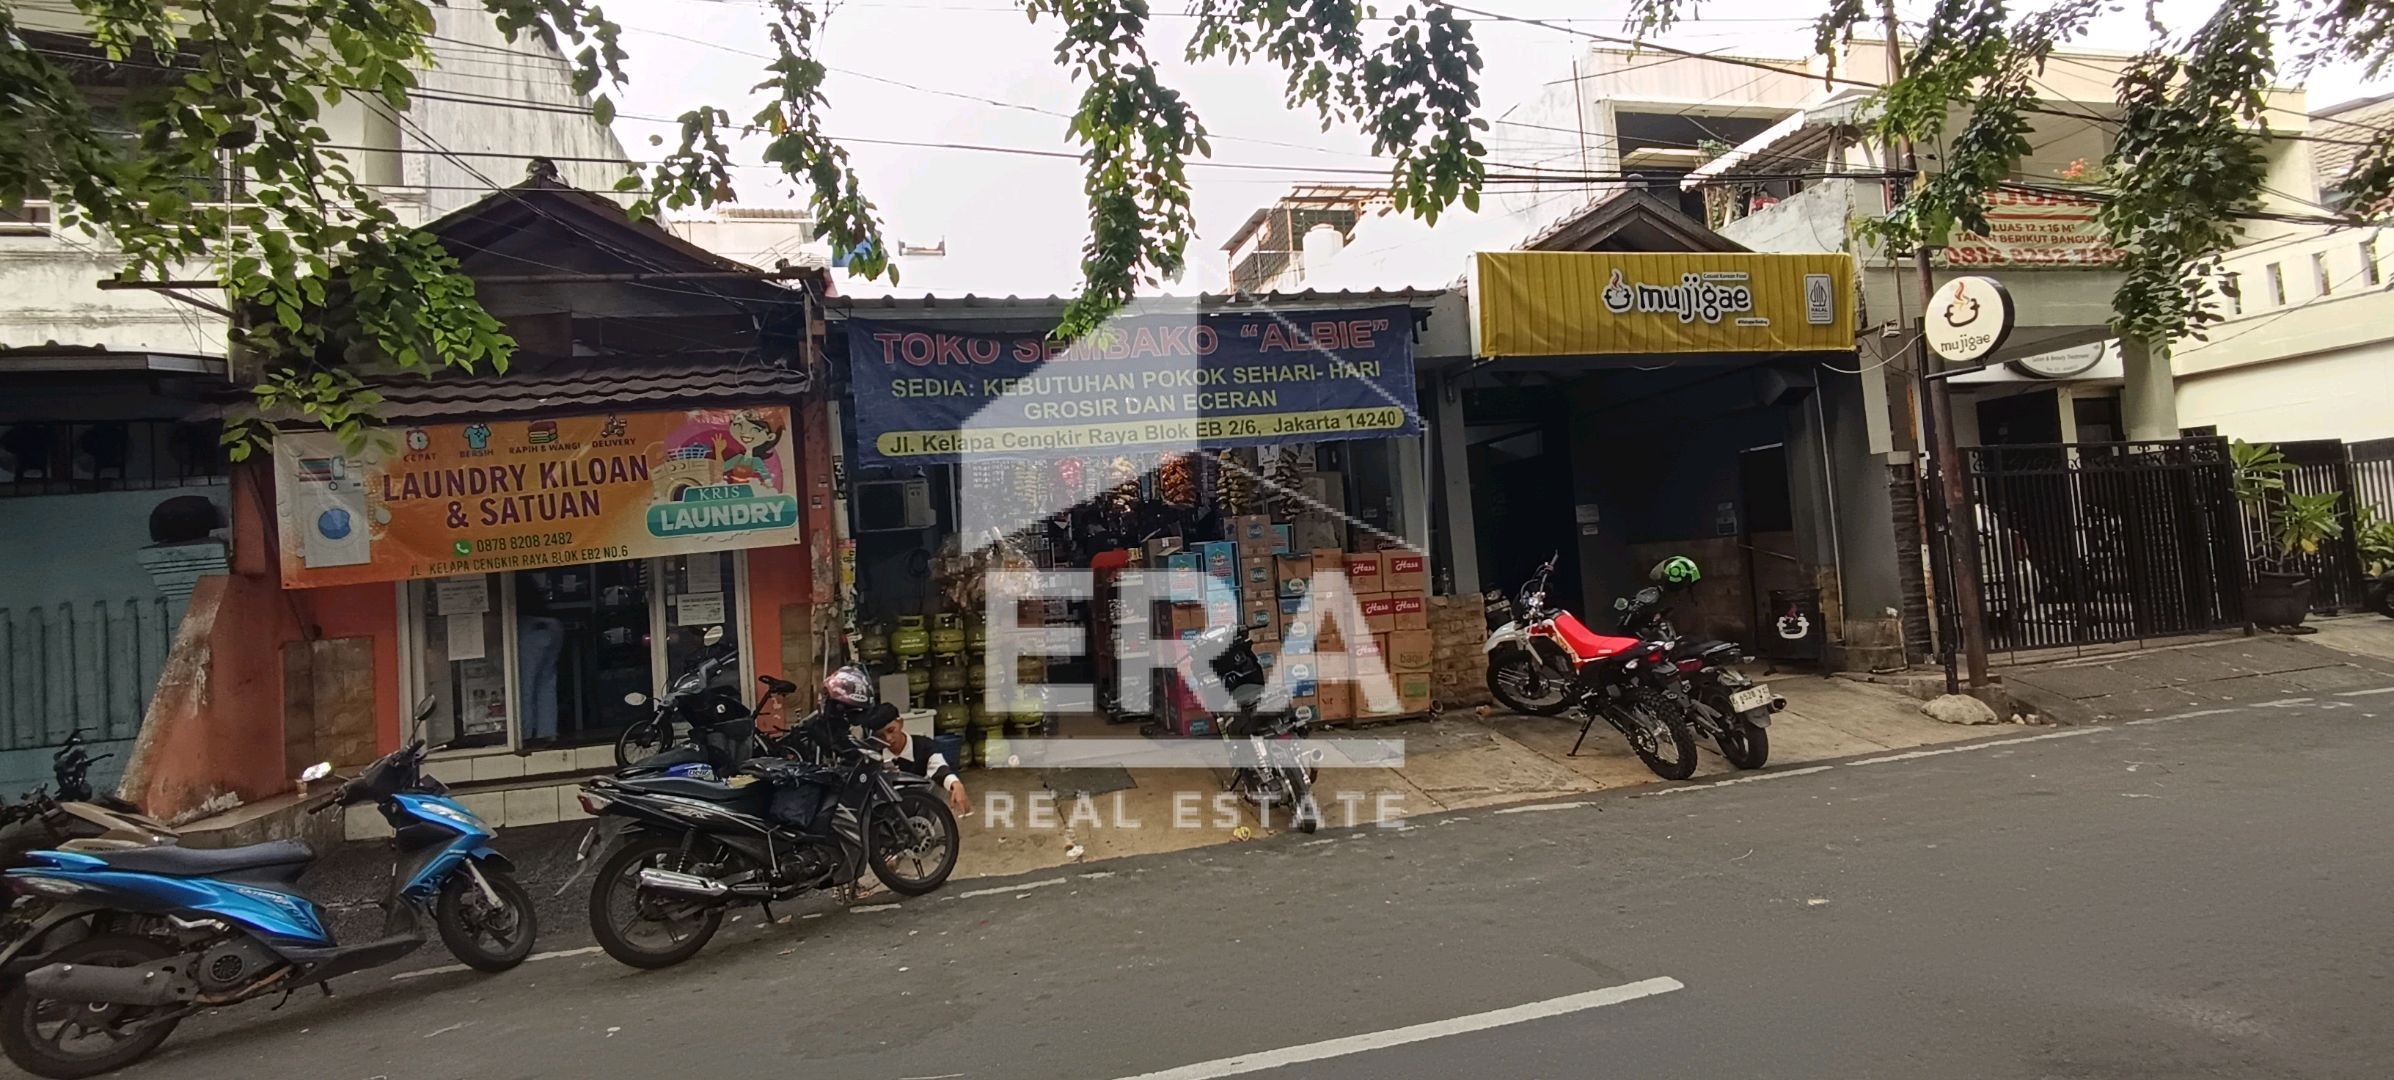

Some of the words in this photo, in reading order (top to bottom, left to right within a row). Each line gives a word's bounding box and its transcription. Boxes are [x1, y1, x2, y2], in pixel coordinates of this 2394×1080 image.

[1992, 223, 2022, 232] LUAS
[2000, 234, 2049, 244] BERIKUT
[1638, 275, 1749, 321] mujigae
[874, 333, 1000, 366] TOKO
[1013, 325, 1218, 363] SEMBAKO
[1940, 333, 1991, 353] mujigae
[891, 378, 975, 398] SEDIA:
[984, 371, 1135, 397] KEBUTUHAN
[1143, 367, 1227, 389] POKOK
[1329, 360, 1381, 379] HARI
[1024, 399, 1118, 420] GROSIR
[1126, 395, 1176, 415] DAN
[1183, 389, 1278, 412] ECERAN
[592, 438, 637, 449] DELIVERY
[890, 436, 915, 454] Jl.
[922, 432, 994, 454] Kelapa
[1001, 429, 1082, 450] Cengkir
[1095, 426, 1138, 447] Raya
[1145, 424, 1189, 442] Blok
[1196, 421, 1222, 438] EB
[1228, 418, 1261, 437] 2/6,
[1272, 415, 1340, 433] Jakarta
[1345, 410, 1396, 429] 14240
[403, 453, 436, 462] CEPAT
[459, 448, 494, 458] BERSIH
[541, 444, 547, 453] &
[549, 441, 581, 452] WANGI
[383, 464, 527, 502] LAUNDRY
[540, 453, 649, 490] KILOAN
[699, 485, 741, 501] KRIS
[446, 500, 470, 529] &
[480, 489, 601, 527] SATUAN
[659, 501, 785, 531] LAUNDRY
[476, 537, 507, 554] 0878
[510, 534, 541, 551] 8208
[543, 531, 573, 547] 2482
[429, 559, 470, 574] KELAPA
[473, 554, 520, 571] CENGKIR
[522, 552, 548, 567] RAYA
[551, 549, 578, 564] BLOK
[581, 546, 601, 561] EB2
[603, 545, 629, 559] NO.6
